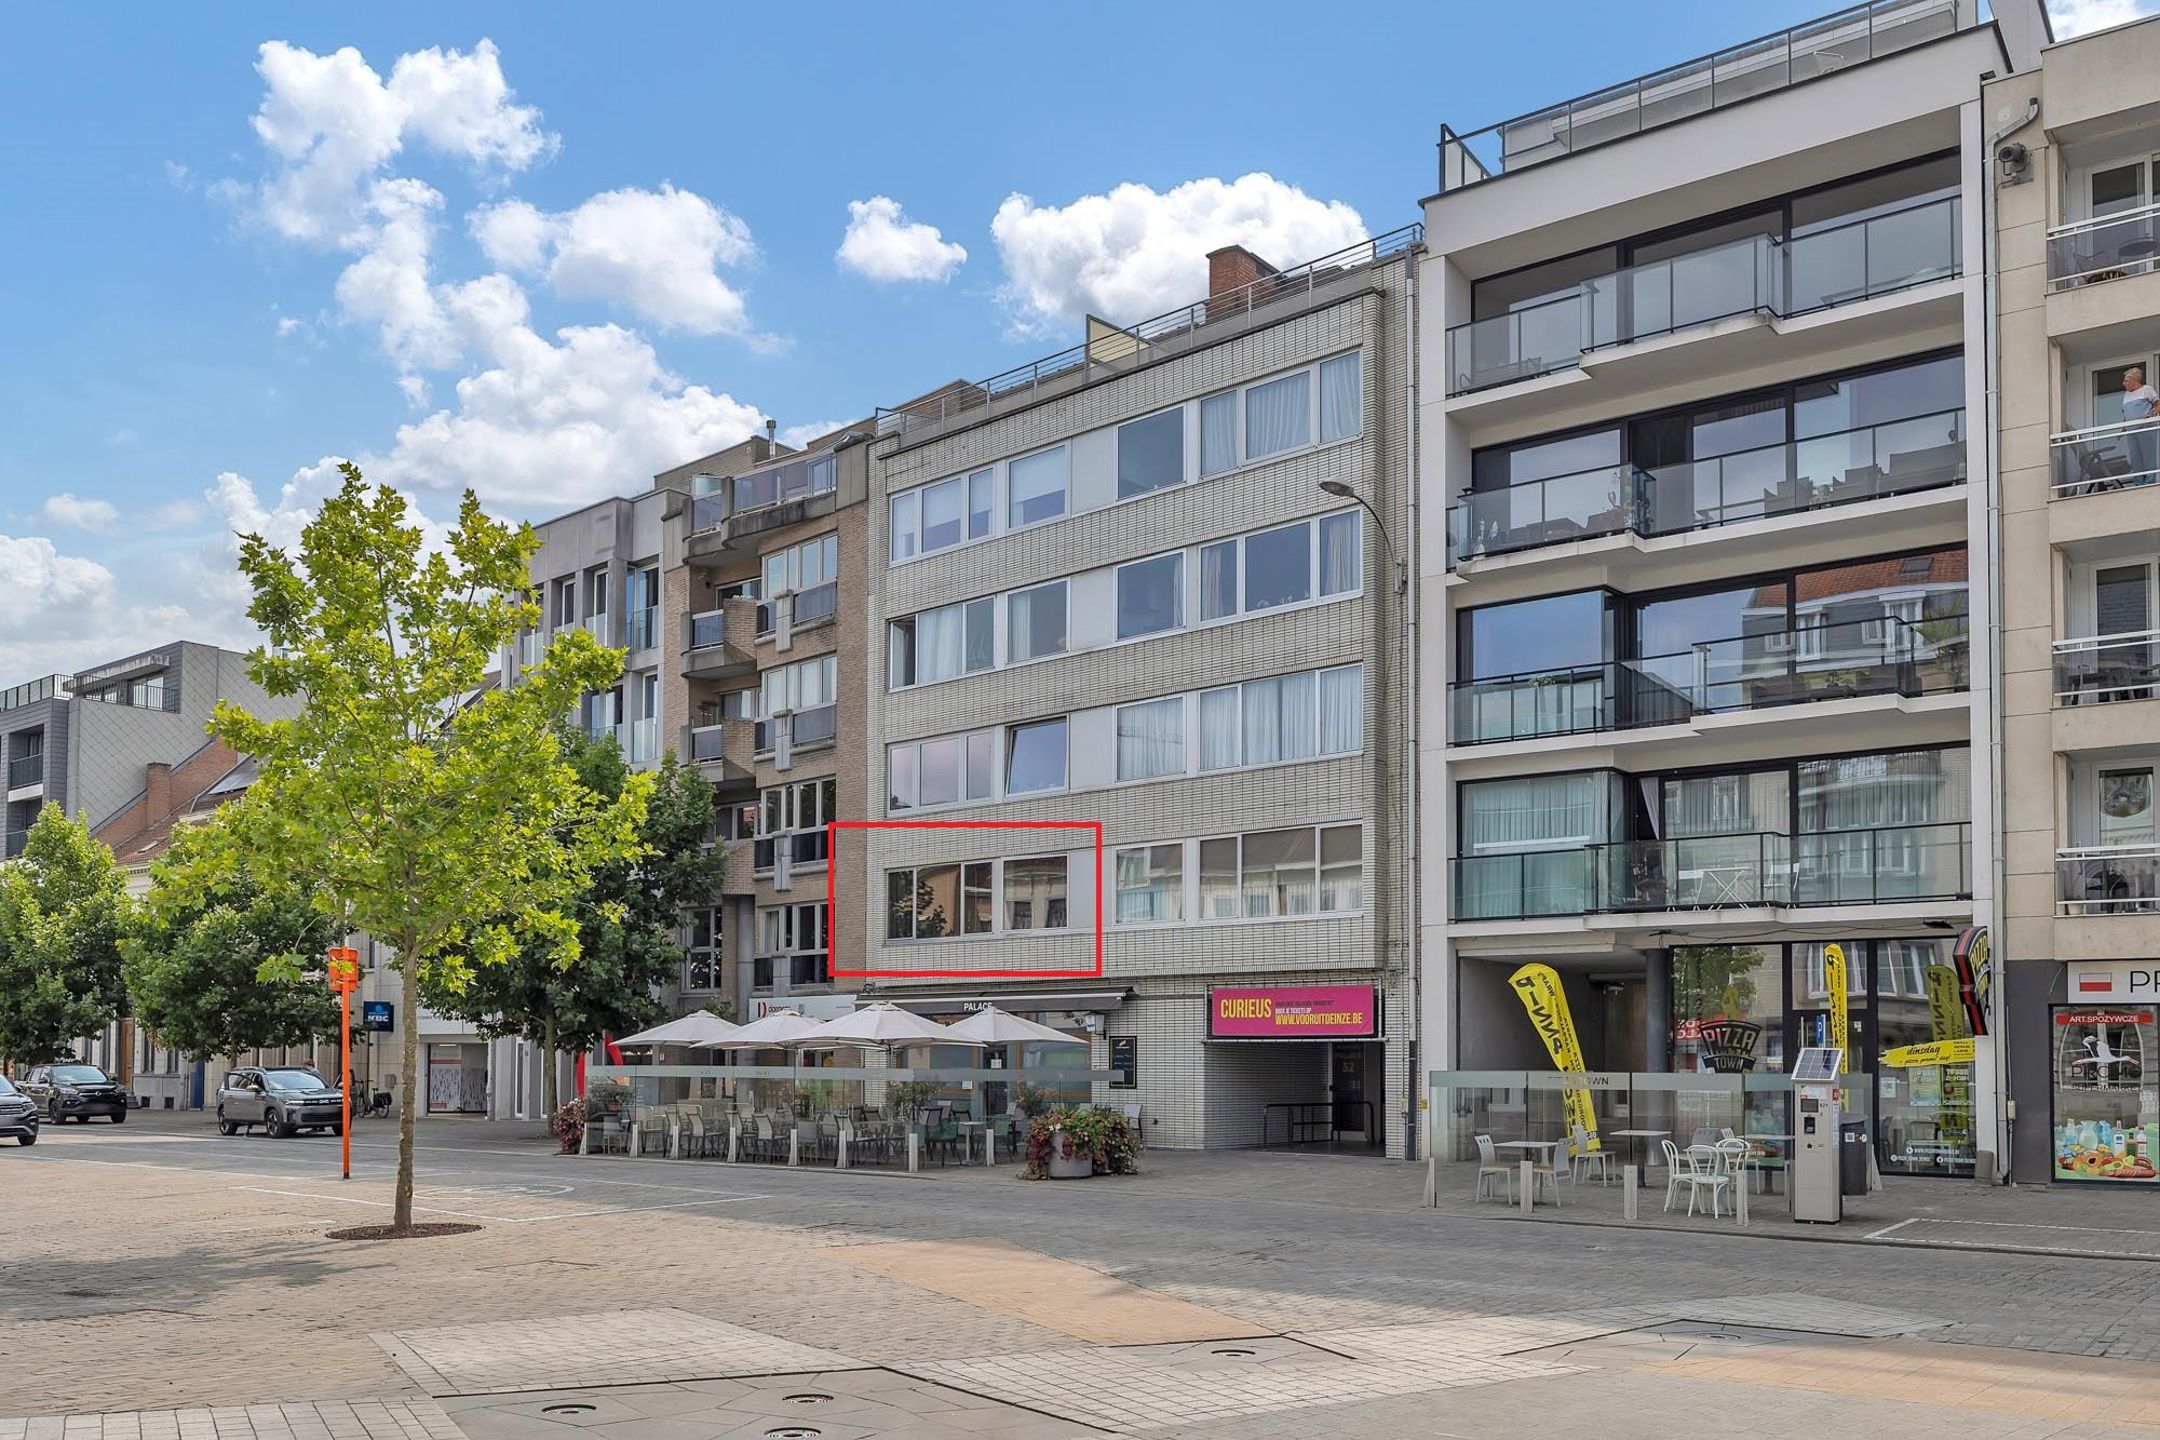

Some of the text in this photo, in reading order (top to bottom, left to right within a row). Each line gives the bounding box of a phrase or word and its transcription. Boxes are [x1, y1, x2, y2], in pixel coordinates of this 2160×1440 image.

[1221, 998, 1272, 1018] CURIEUS
[1703, 1027, 1757, 1053] PIZZA
[1906, 1045, 1941, 1058] dinsdag
[1713, 1056, 1744, 1069] TOWN
